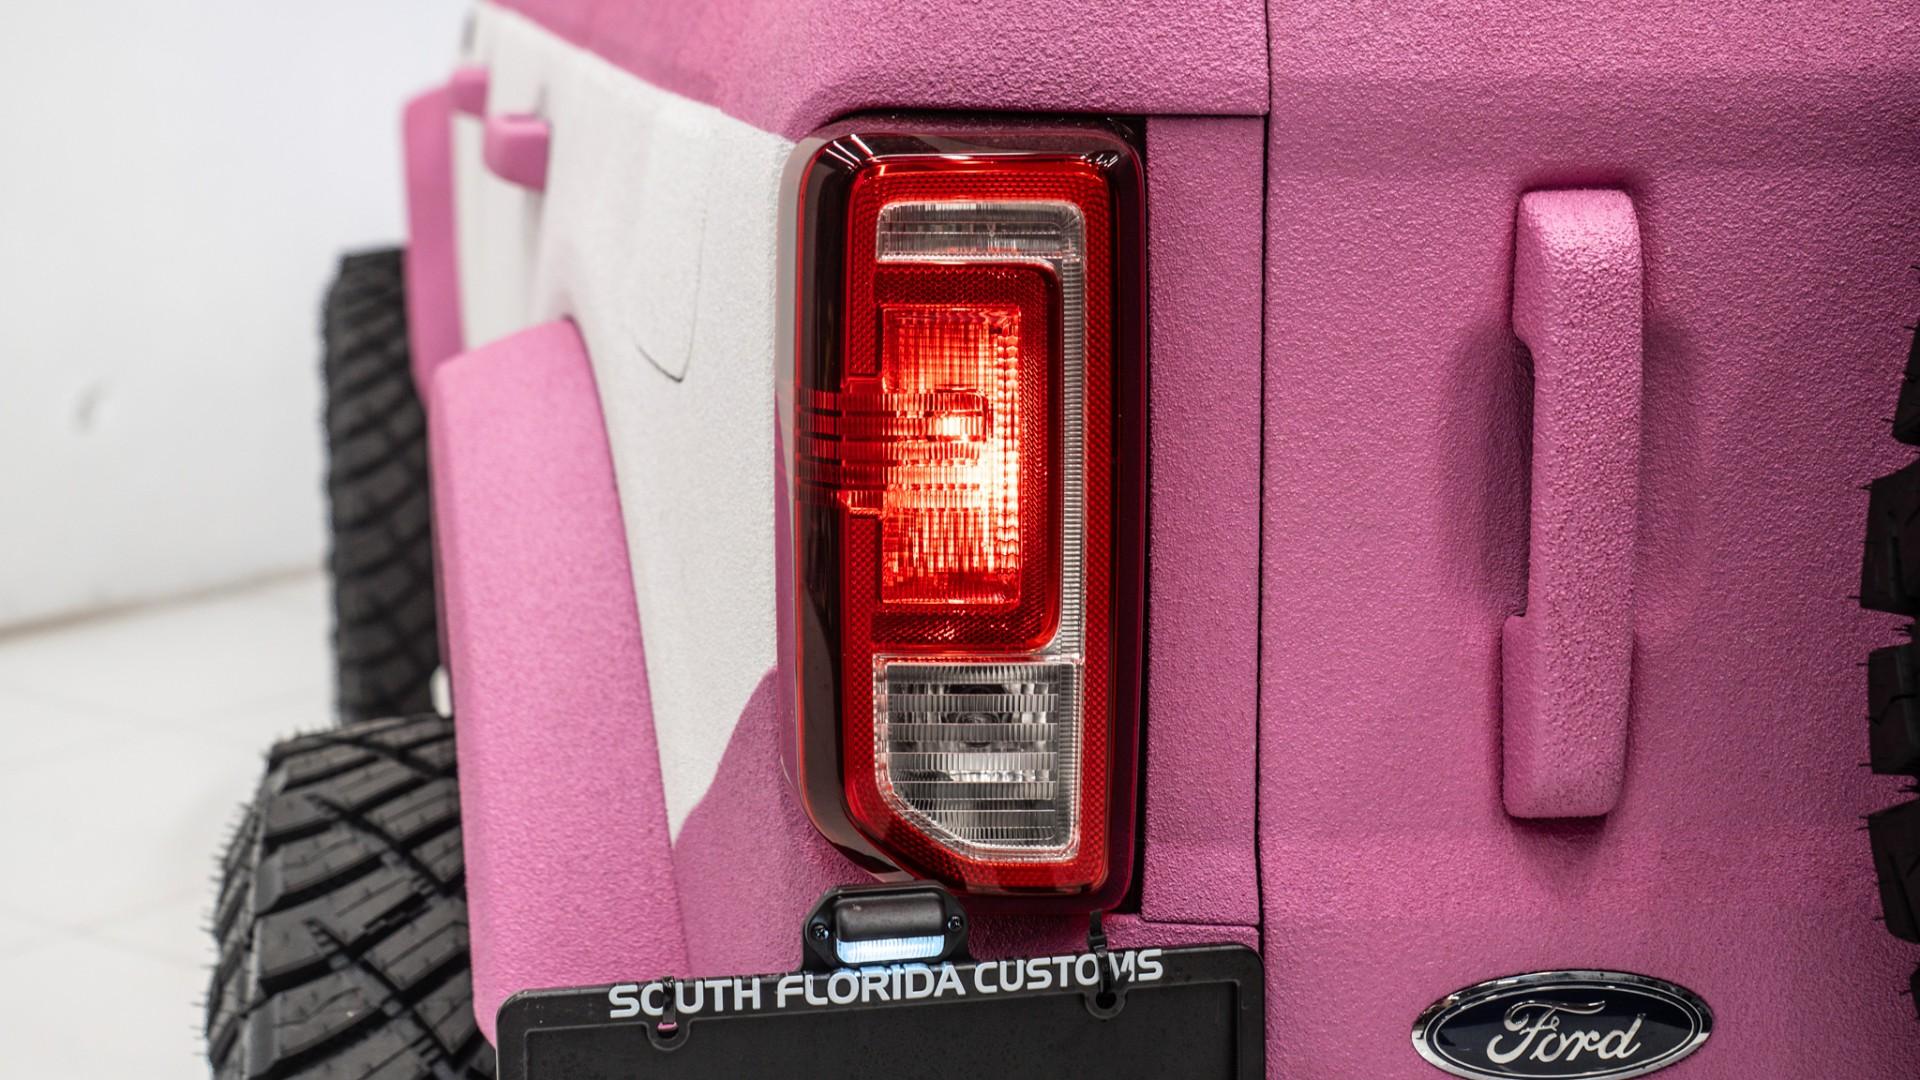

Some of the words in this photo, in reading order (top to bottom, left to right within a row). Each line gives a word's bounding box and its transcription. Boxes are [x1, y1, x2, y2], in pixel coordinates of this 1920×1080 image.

[608, 977, 761, 1019] SOUTH
[776, 963, 966, 1008] FLORIDA
[974, 949, 1164, 994] CUSTOMS
[1486, 1000, 1647, 1064] Ford
